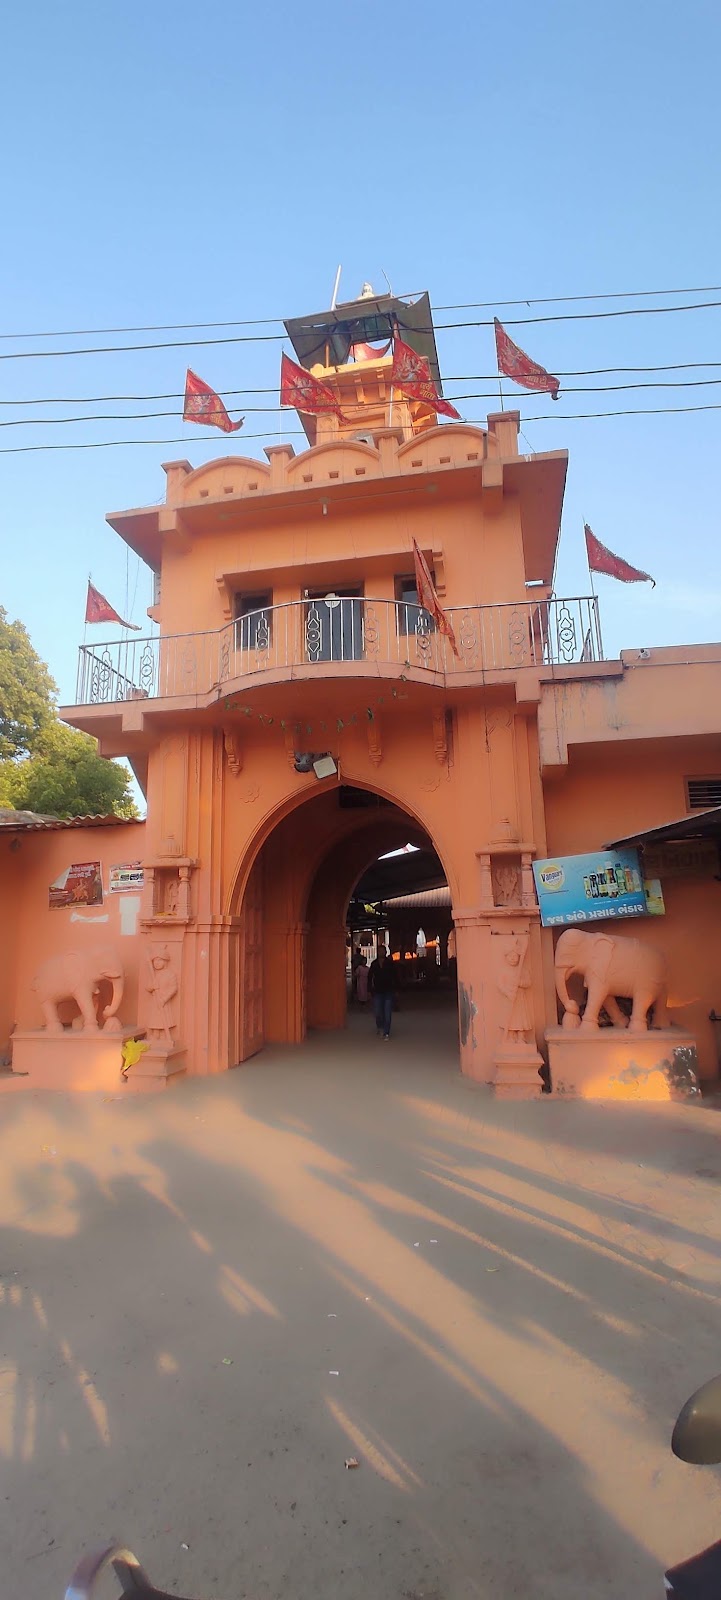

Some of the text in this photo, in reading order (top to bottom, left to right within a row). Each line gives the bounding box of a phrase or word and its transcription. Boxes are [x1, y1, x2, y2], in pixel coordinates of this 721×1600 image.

[546, 904, 644, 924] જય અંબે પ્રસાદ ભંડાર
